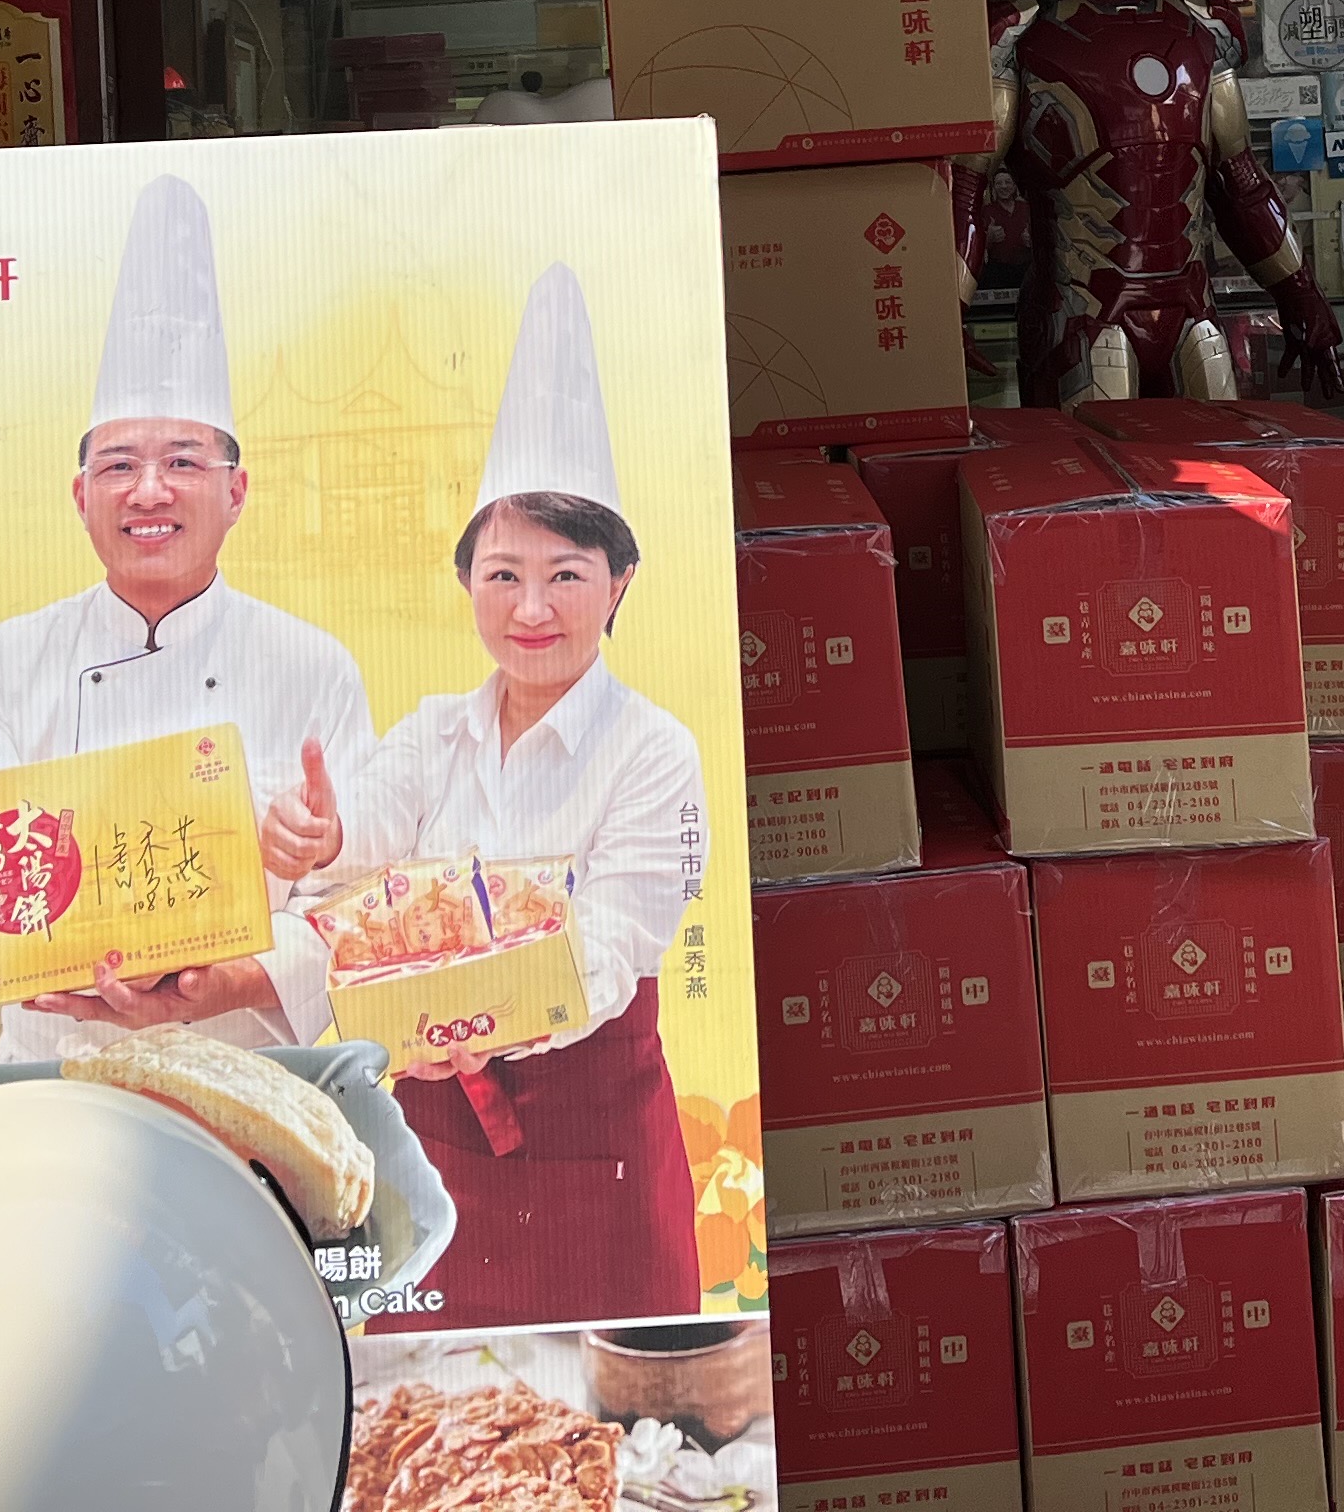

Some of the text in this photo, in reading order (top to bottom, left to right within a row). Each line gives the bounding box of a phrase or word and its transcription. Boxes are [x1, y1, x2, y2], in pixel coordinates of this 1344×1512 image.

[871, 263, 909, 352] 嘉味軒
[1227, 611, 1247, 628] 中
[829, 642, 850, 660] 中
[1118, 638, 1179, 657] 嘉味軒
[1080, 754, 1234, 775] 一通電話 宅配到府
[6, 798, 54, 943] 太陽餅
[679, 800, 708, 1000] 台中市長 盧秀燕
[1268, 951, 1288, 969] 中
[313, 1245, 383, 1281] 陽餅
[359, 1285, 445, 1317] Cake
